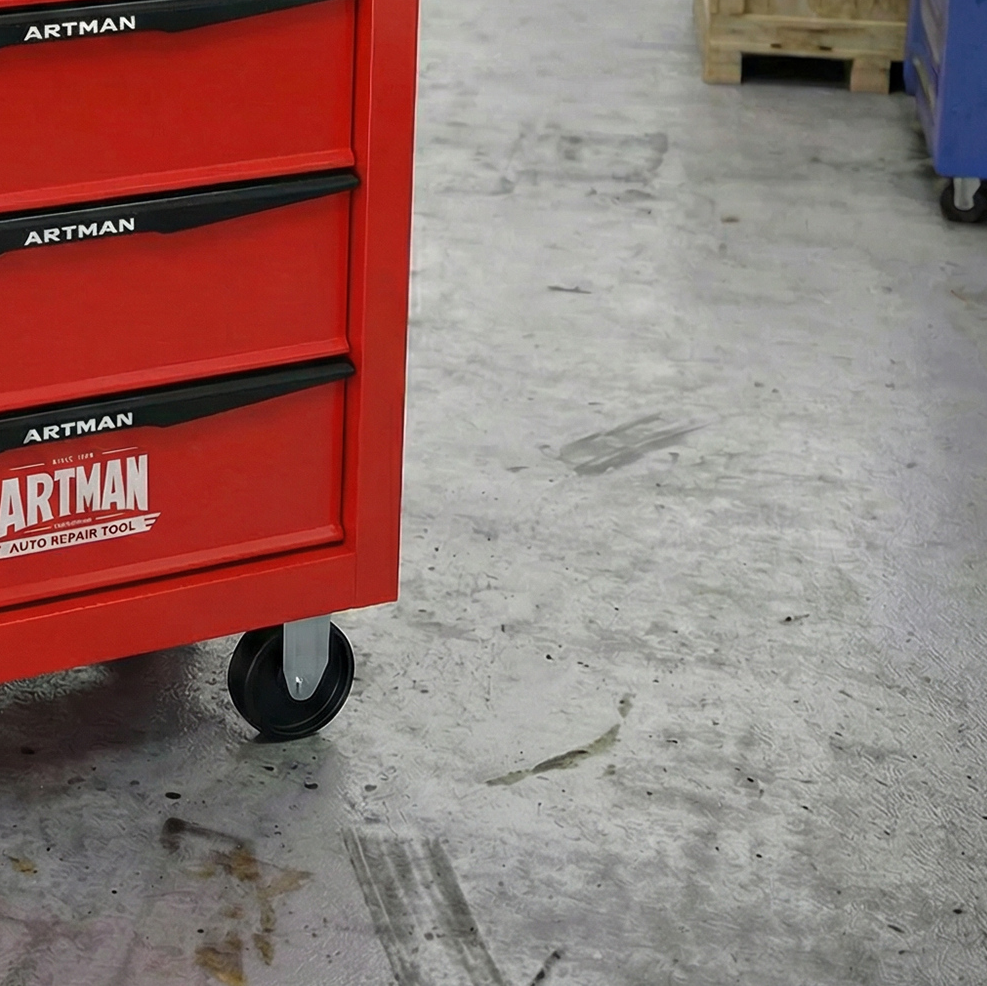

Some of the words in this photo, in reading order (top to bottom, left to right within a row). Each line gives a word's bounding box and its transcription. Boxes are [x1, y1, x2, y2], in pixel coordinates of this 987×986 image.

[23, 15, 136, 42] ARTMAN
[23, 217, 135, 247] ARTMAN
[23, 412, 133, 444] ARTMAN
[9, 538, 47, 554] AUTO
[51, 528, 98, 545] REPAIR
[101, 520, 136, 536] TOOL
